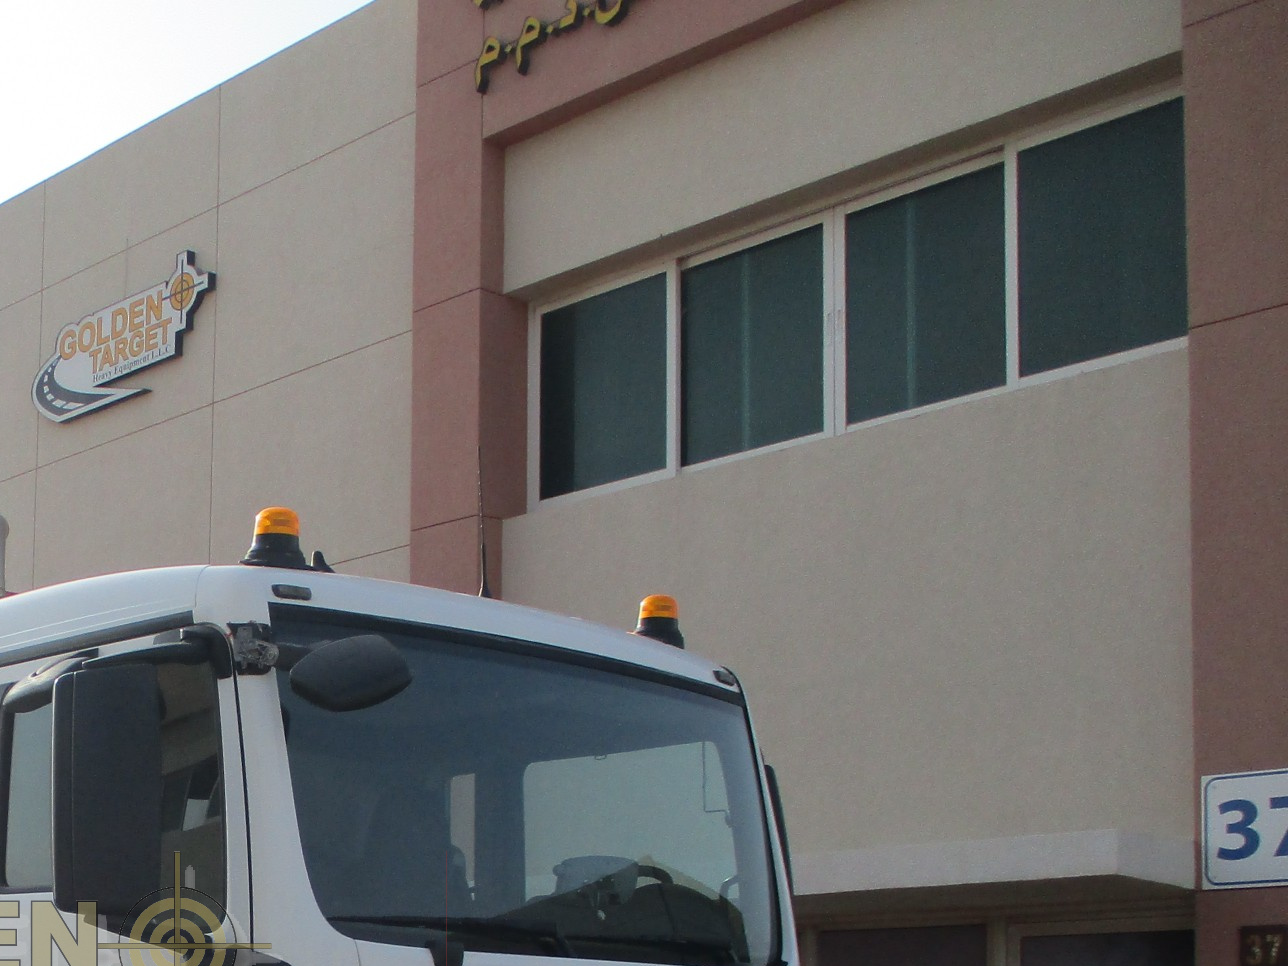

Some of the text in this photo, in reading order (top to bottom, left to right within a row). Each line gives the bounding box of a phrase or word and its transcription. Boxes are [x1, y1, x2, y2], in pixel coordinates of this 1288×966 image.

[59, 290, 162, 360] GOLDEN
[89, 317, 172, 374] TARGET
[92, 370, 113, 383] Heavy
[114, 354, 150, 375] Equipment
[1245, 932, 1283, 966] 37
